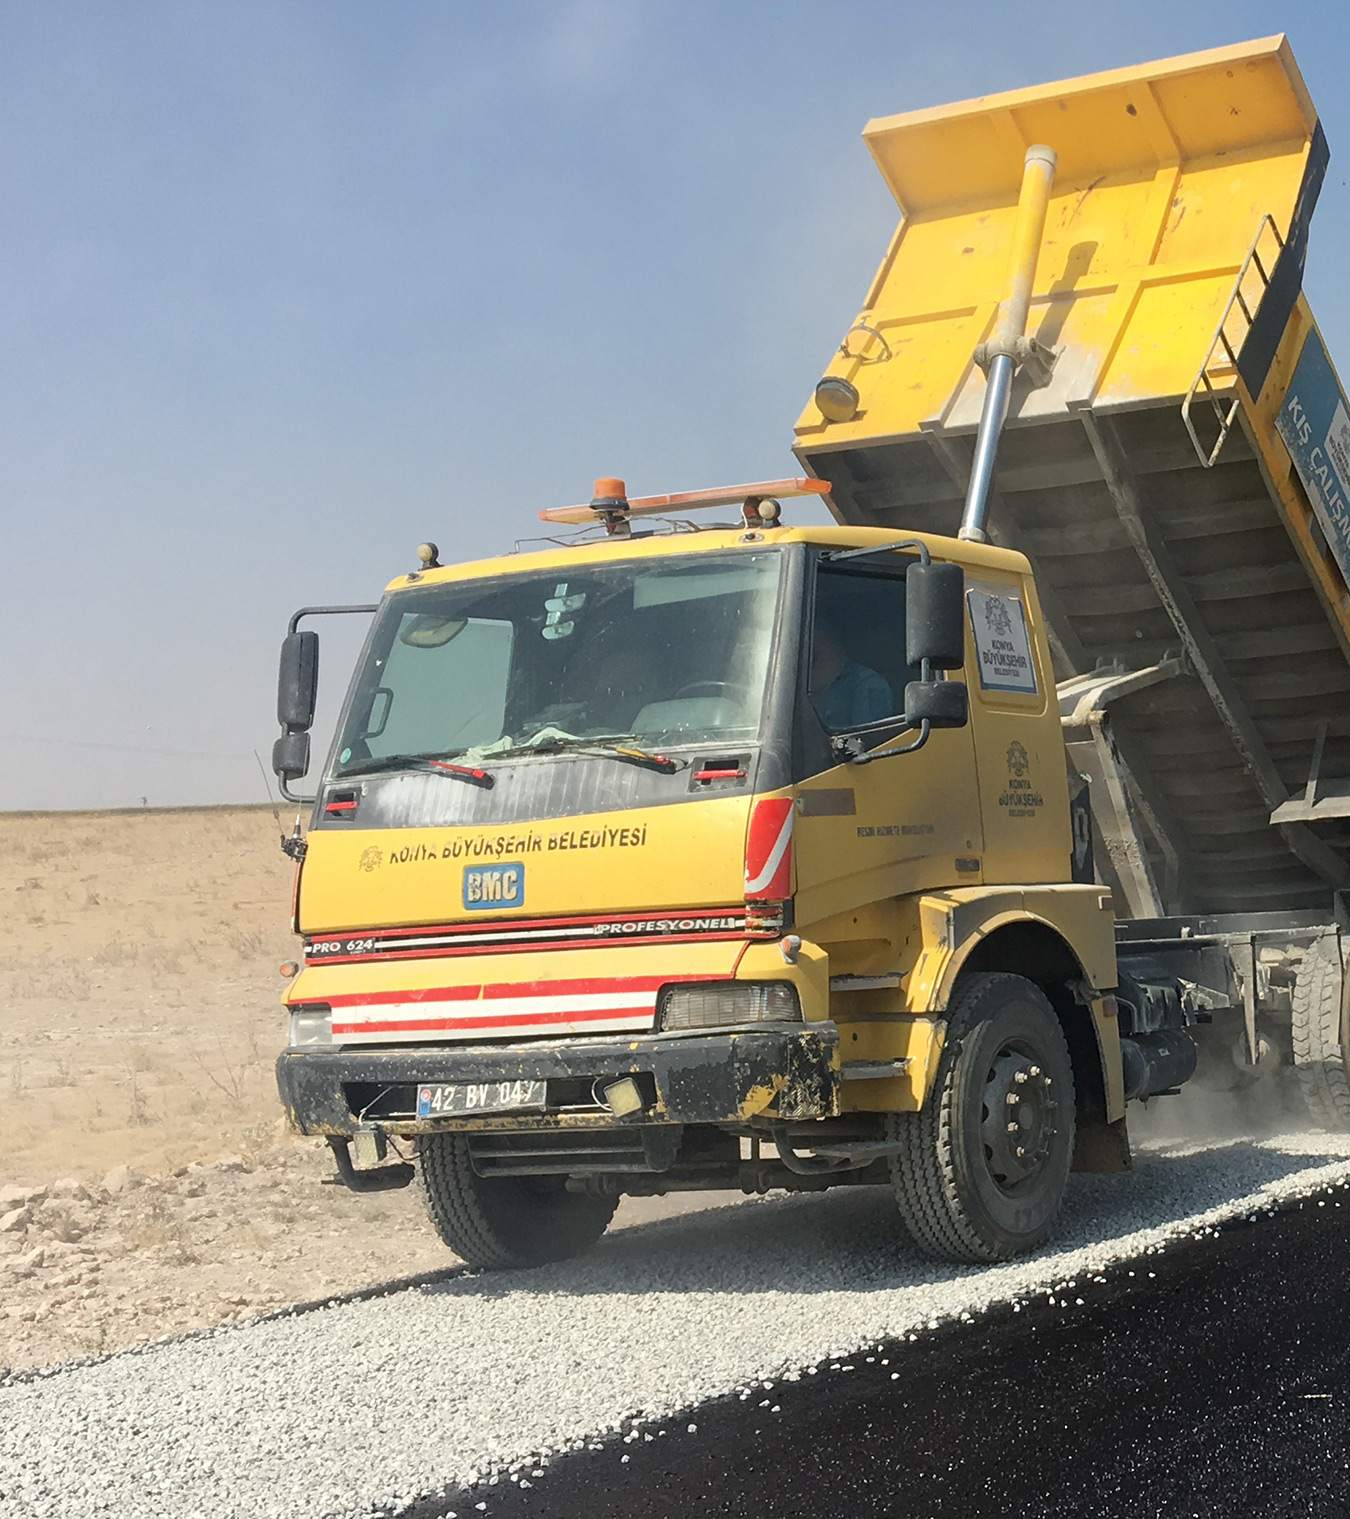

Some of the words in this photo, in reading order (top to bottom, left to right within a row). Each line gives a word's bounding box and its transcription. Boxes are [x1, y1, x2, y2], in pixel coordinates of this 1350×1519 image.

[1287, 396, 1313, 446] KIŞ
[991, 639, 1015, 652] KONYA
[547, 822, 648, 851] BELEDİYESİ
[467, 870, 519, 902] BMC
[599, 917, 731, 934] PROFESYONEL
[312, 942, 342, 954] PRO
[346, 939, 373, 951] 624
[431, 1086, 456, 1112] 42
[465, 1083, 489, 1109] BV
